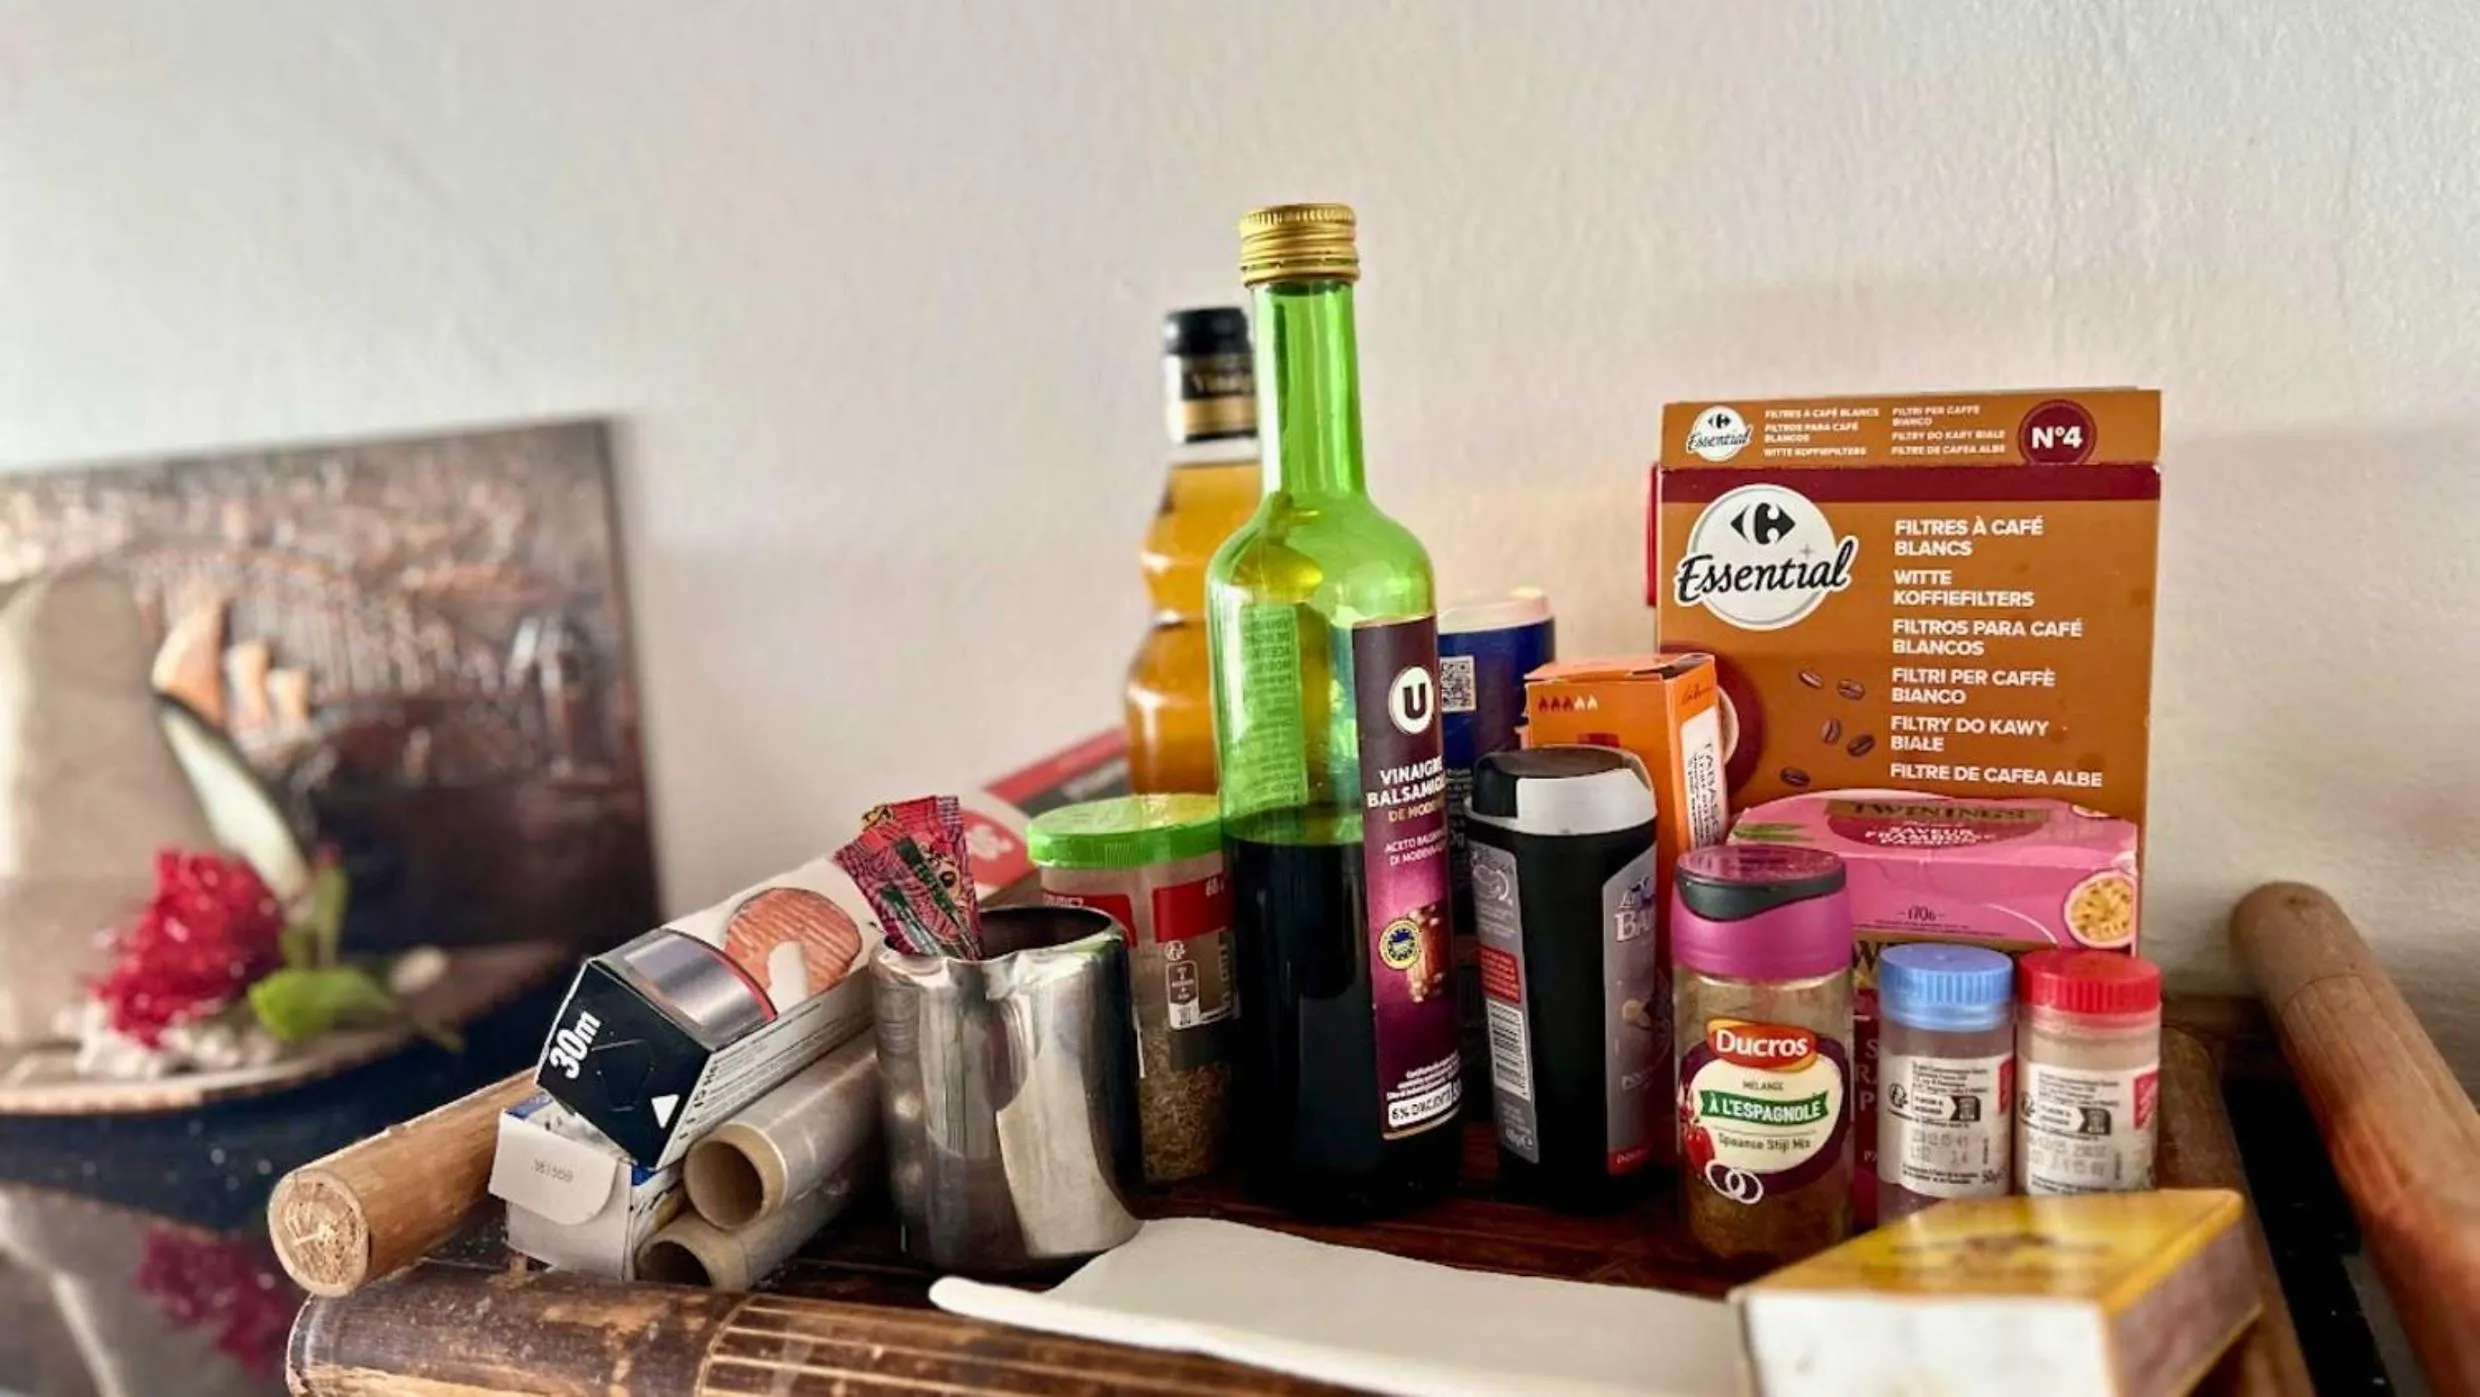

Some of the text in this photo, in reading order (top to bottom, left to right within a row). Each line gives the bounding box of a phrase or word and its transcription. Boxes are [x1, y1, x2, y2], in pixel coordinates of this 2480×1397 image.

[1688, 425, 1752, 451] Essential
[1894, 516, 2044, 536] FILTRES À CAFÉ
[1894, 540, 1973, 557] BLANCS
[1677, 540, 1853, 602] Essential
[1893, 569, 1952, 585] WITTE
[1893, 590, 2035, 607] KOFFIEFILTERS
[1892, 618, 2083, 637] FILTROS PARA CAFÉ
[1892, 639, 1985, 656] BLANCOS
[1892, 667, 2056, 687] FILTRI PER CAFFÈ
[1402, 683, 1428, 720] U
[1891, 687, 1967, 705] BIANCO
[1890, 716, 2050, 737] FILTRY DO KAWY
[1890, 763, 2104, 788] FILTRE DE CAFEA ALBE
[1854, 803, 2026, 819] TWININGS
[549, 1010, 602, 1079] 30m
[1716, 1029, 1809, 1057] Ducros
[1708, 1096, 1822, 1123] À L'ESPAGNOLE
